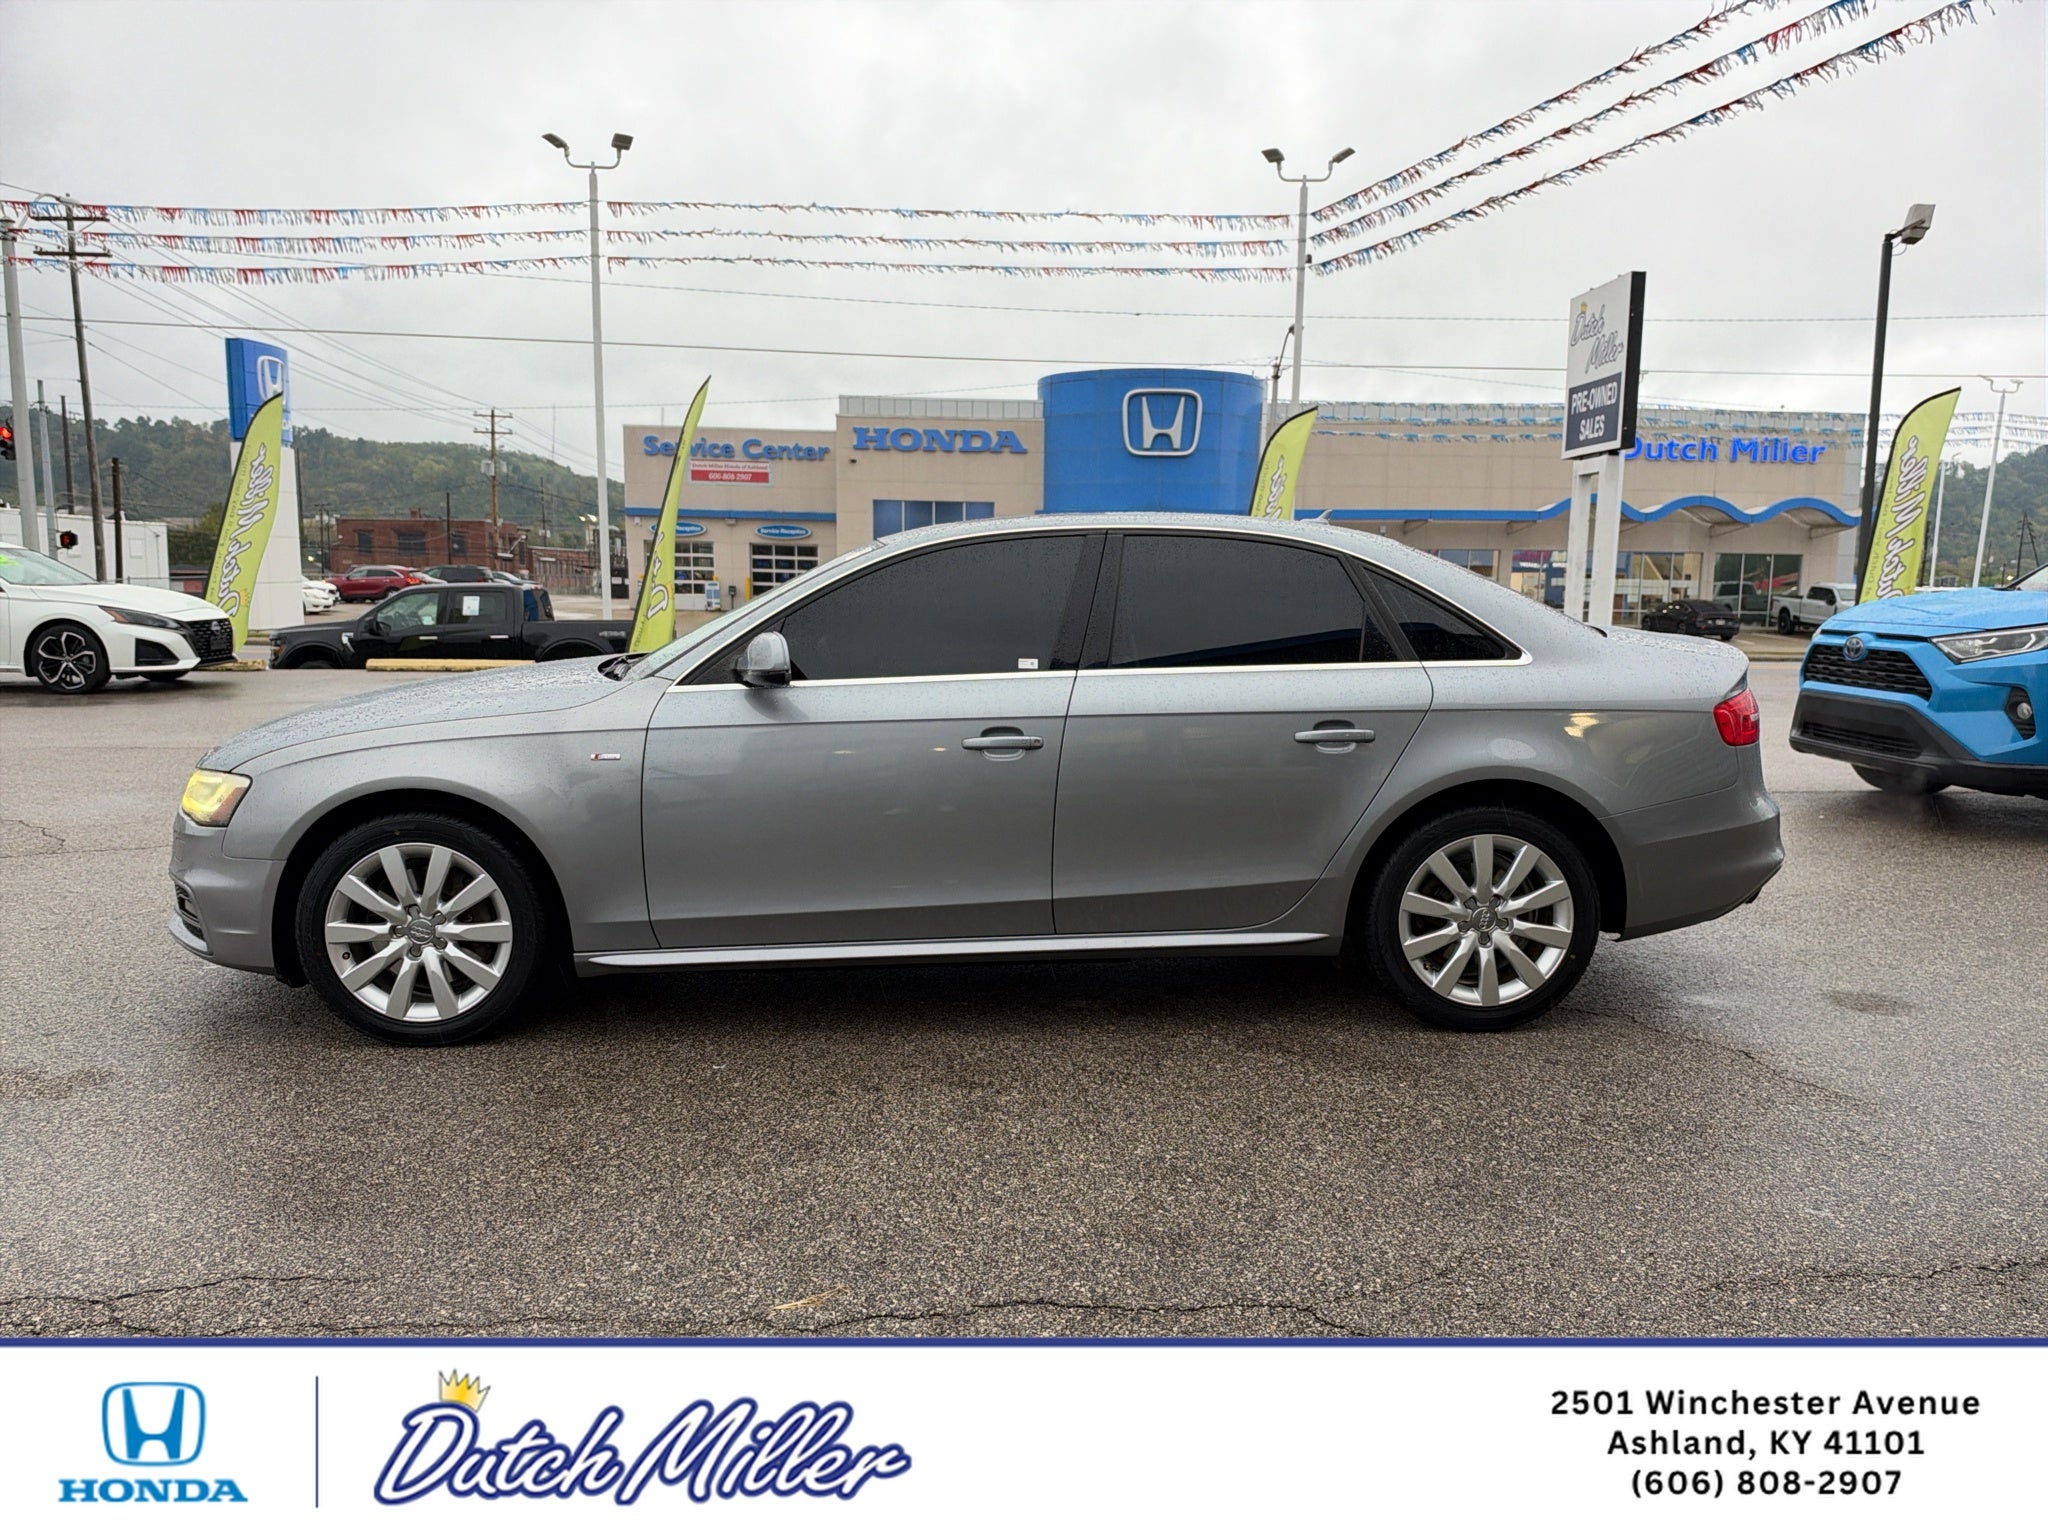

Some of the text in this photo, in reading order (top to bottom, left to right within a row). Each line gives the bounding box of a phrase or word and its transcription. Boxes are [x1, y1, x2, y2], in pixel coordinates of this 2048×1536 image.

[1570, 303, 1605, 347] Dutch
[1585, 330, 1624, 374] Miller
[1571, 381, 1618, 415] PRE-OWNED
[852, 426, 1028, 454] HONDA
[1579, 414, 1605, 441] SALES
[643, 435, 830, 461] Sevice Center
[1730, 436, 1826, 464] Miller
